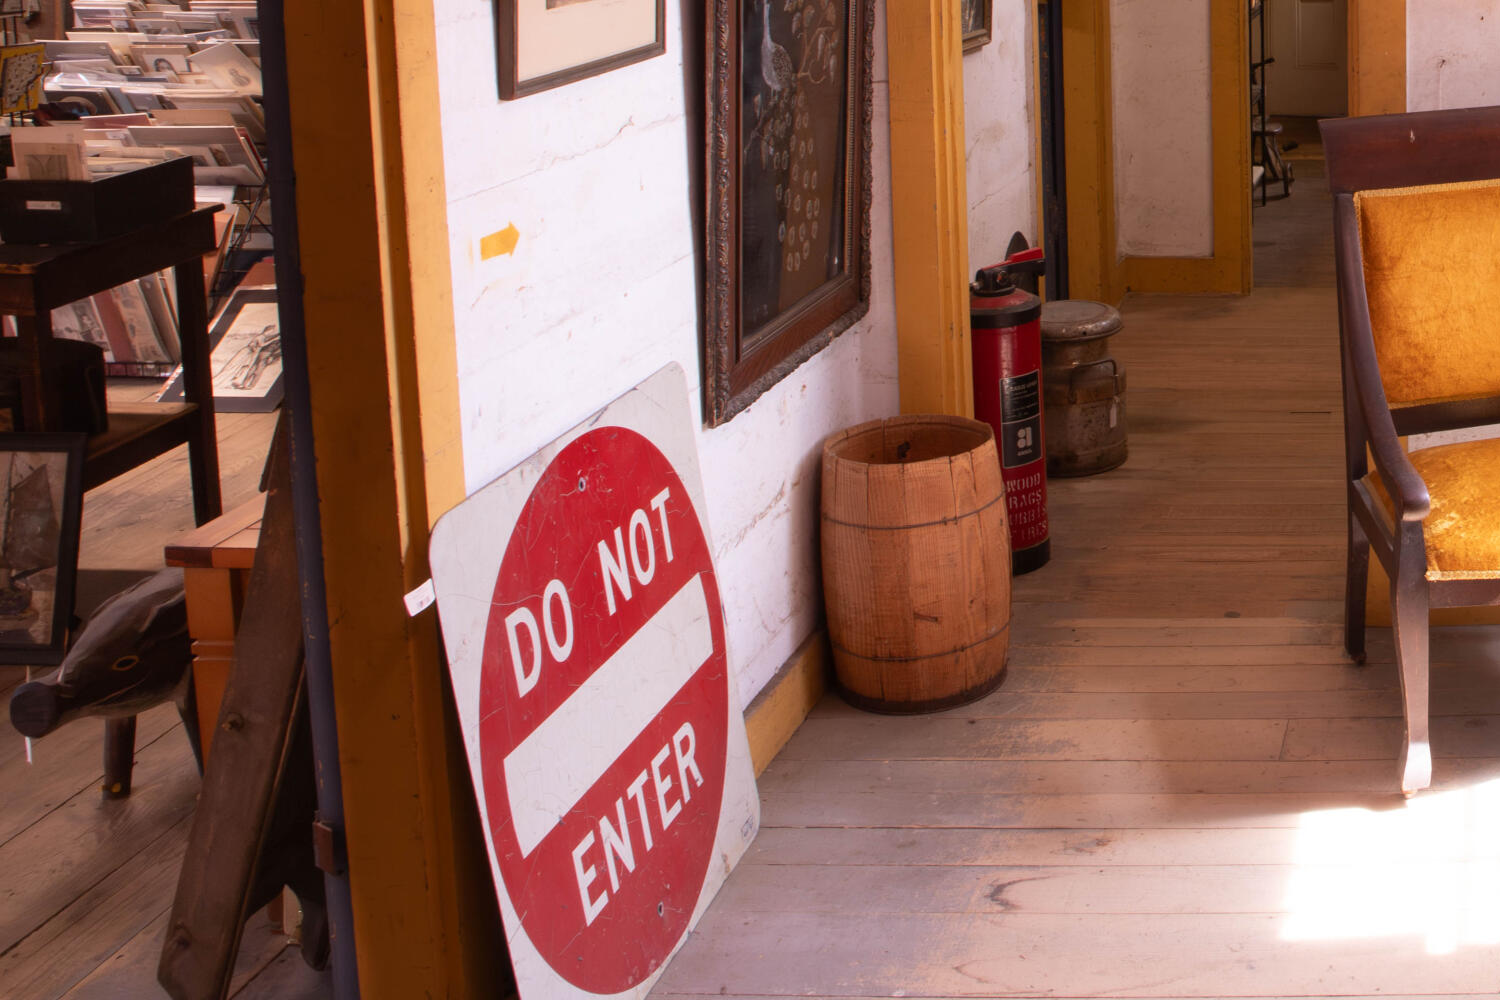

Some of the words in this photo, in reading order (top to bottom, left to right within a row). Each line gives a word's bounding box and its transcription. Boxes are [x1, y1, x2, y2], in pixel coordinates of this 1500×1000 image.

[1006, 472, 1041, 493] WOOD
[1009, 488, 1042, 509] RAGS
[504, 579, 575, 698] DO
[597, 486, 675, 616] NOT
[571, 721, 705, 928] ENTER
